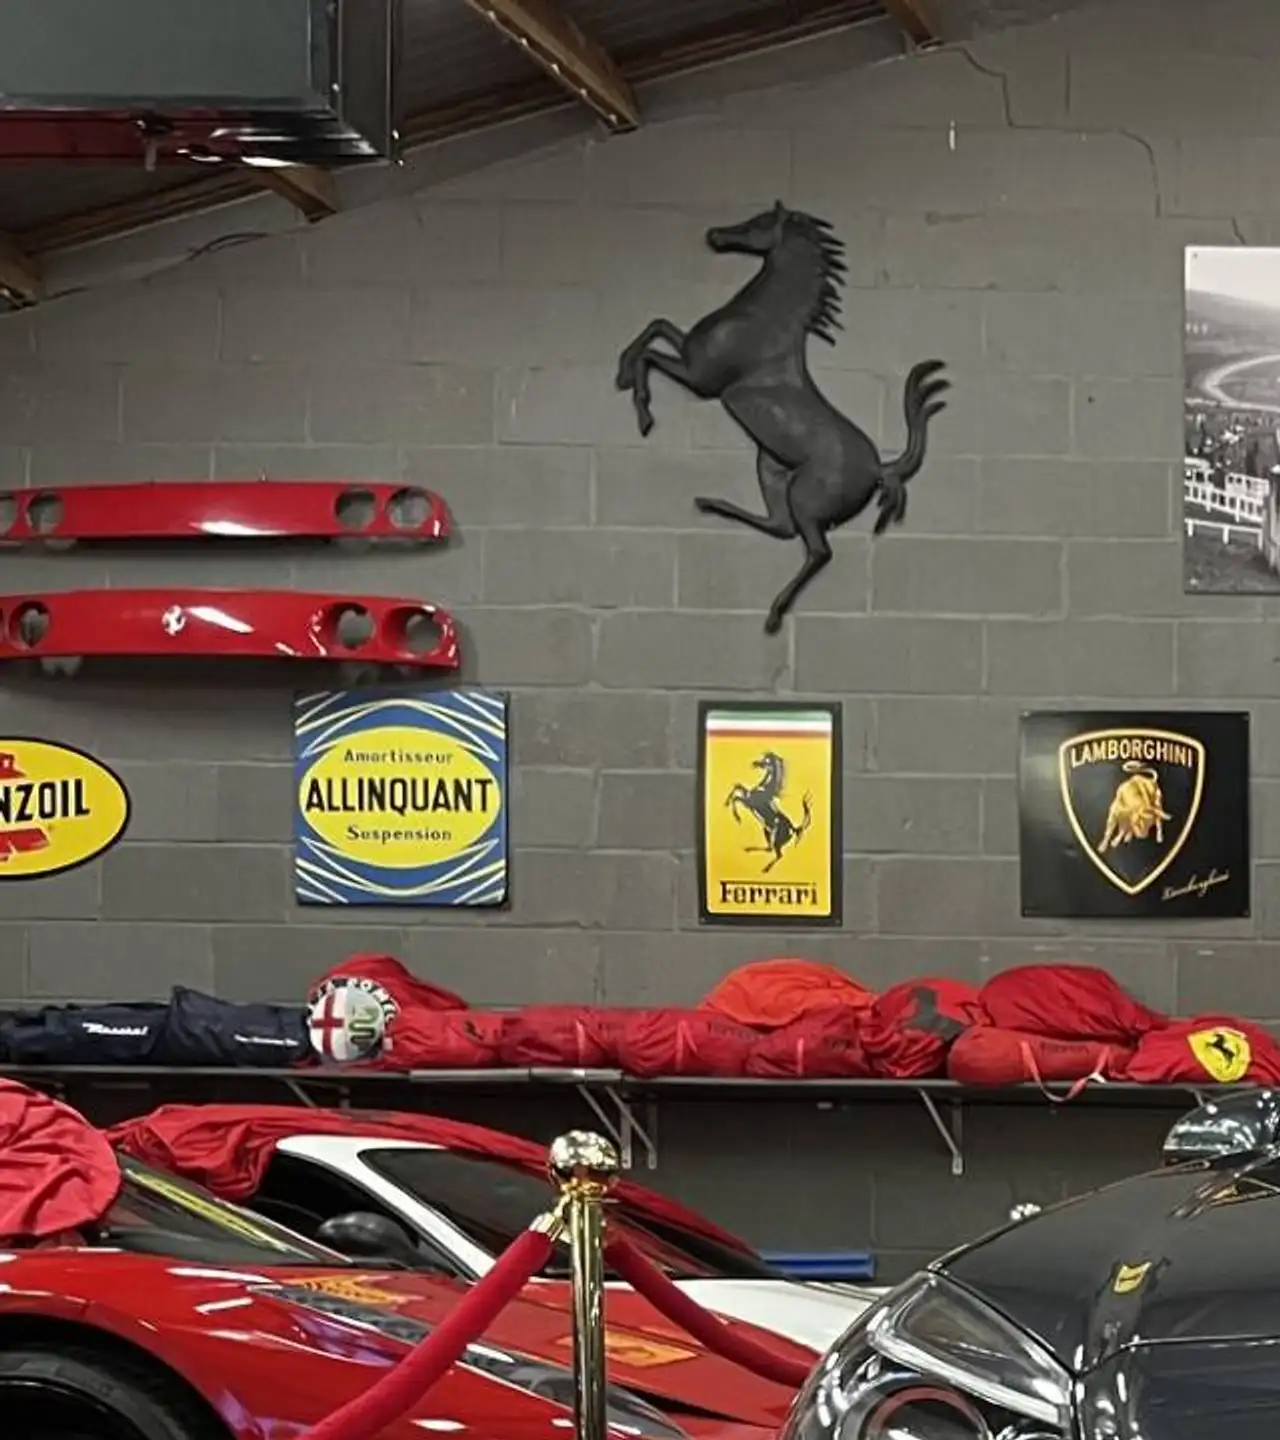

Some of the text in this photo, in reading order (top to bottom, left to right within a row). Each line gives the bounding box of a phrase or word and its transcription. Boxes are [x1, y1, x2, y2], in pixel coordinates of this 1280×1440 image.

[344, 749, 453, 764] Amortisseur
[1071, 738, 1194, 768] LAMBORGHINI
[305, 777, 493, 816] ALLINQUANT
[346, 825, 453, 845] Suspension
[720, 880, 818, 905] Ferrari
